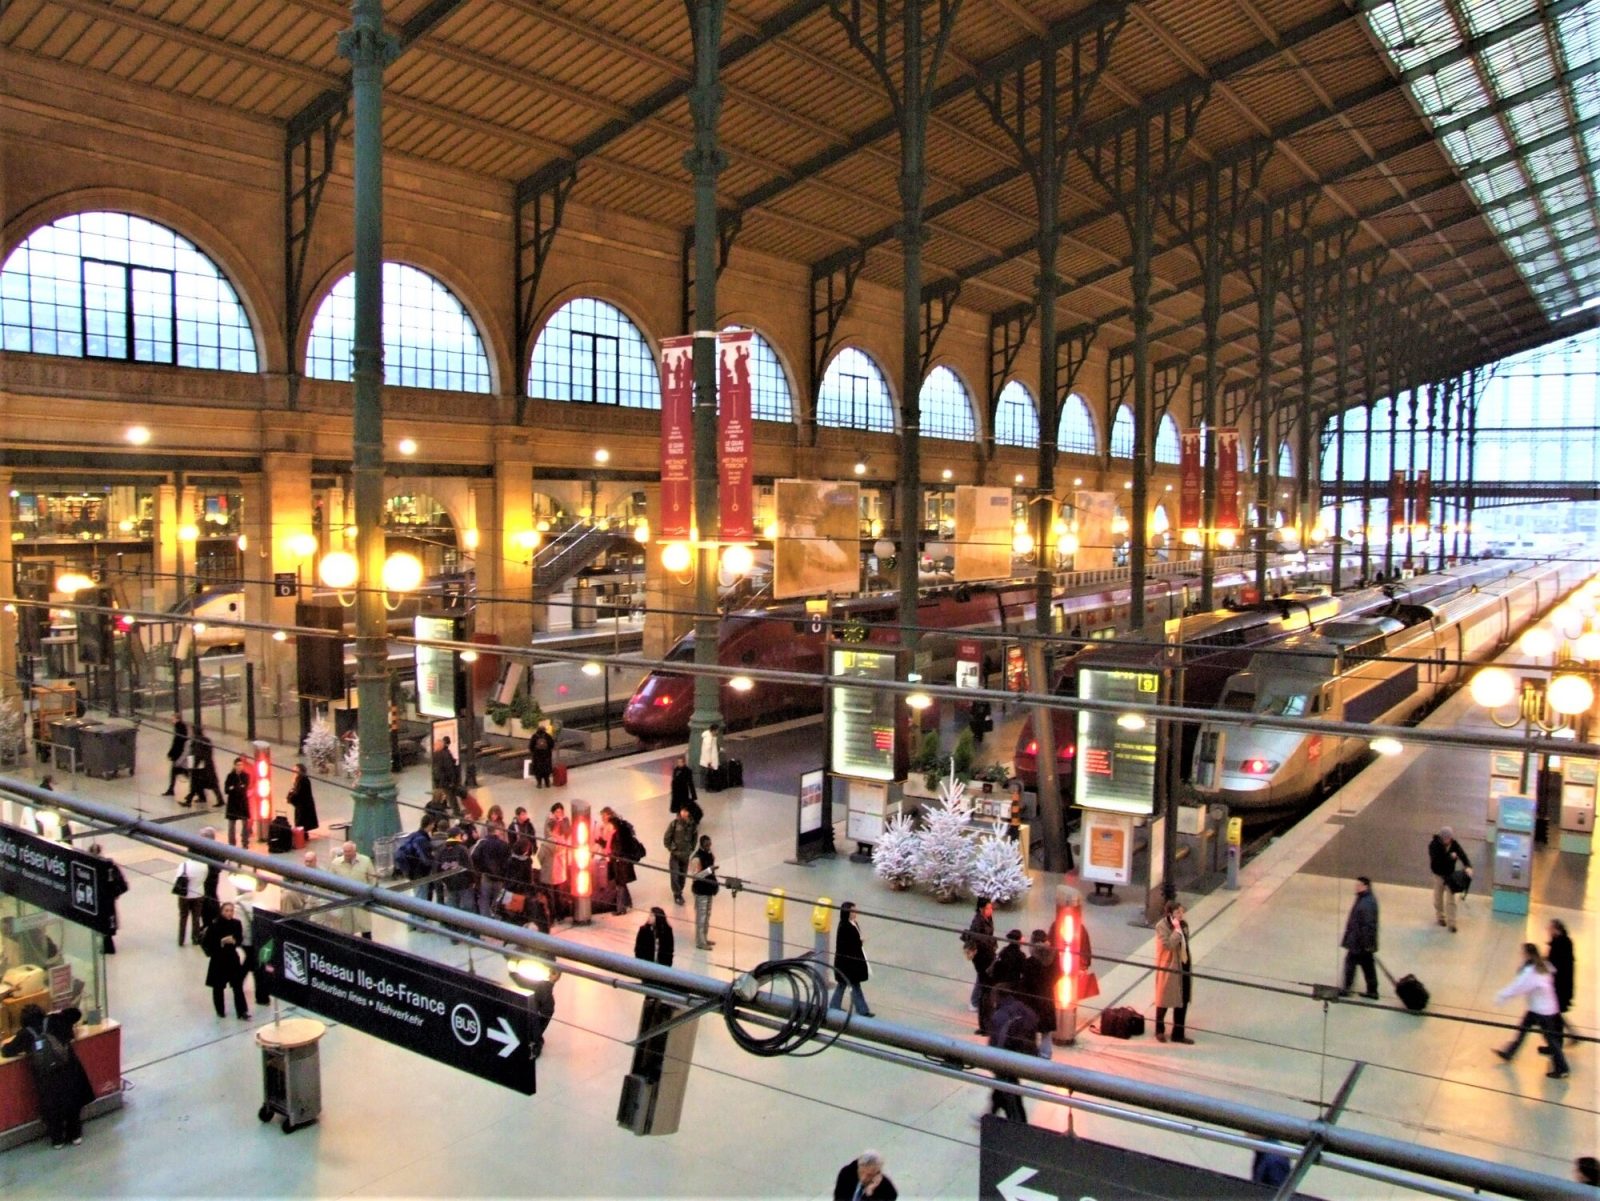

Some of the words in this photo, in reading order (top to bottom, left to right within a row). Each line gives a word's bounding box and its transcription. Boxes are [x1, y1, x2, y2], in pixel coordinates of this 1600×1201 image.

[92, 570, 101, 583] 5
[281, 584, 290, 596] 6
[449, 592, 459, 608] 7
[1143, 679, 1153, 691] 9
[19, 845, 66, 877] réservés
[310, 952, 354, 983] Réseau
[357, 968, 446, 1016] Ile-de-France
[311, 977, 347, 999] Suburban
[348, 990, 368, 1006] lines
[375, 1000, 425, 1027] Nahverkehr
[455, 1015, 477, 1034] BUS
